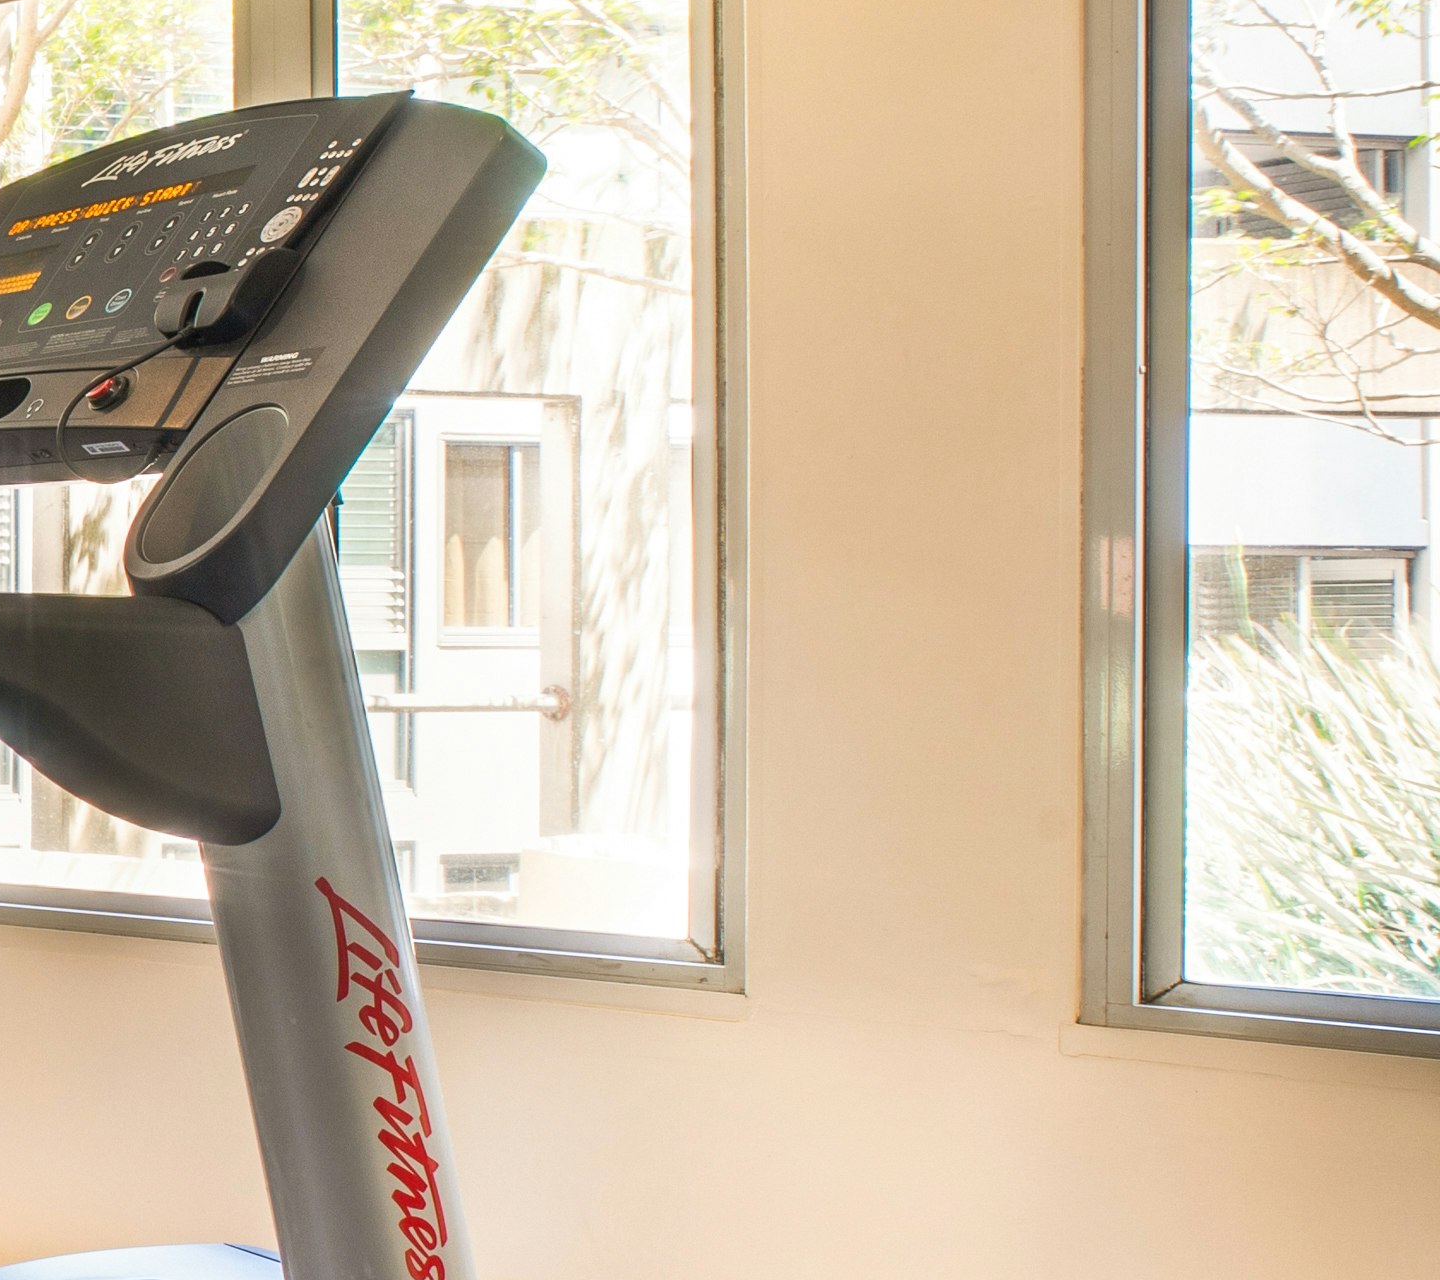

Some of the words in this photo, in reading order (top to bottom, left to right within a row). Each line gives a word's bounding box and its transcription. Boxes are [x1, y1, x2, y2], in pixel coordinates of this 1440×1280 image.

[33, 207, 80, 229] PRESS
[84, 196, 135, 219] QUICK
[140, 183, 193, 207] START
[238, 203, 249, 214] 3
